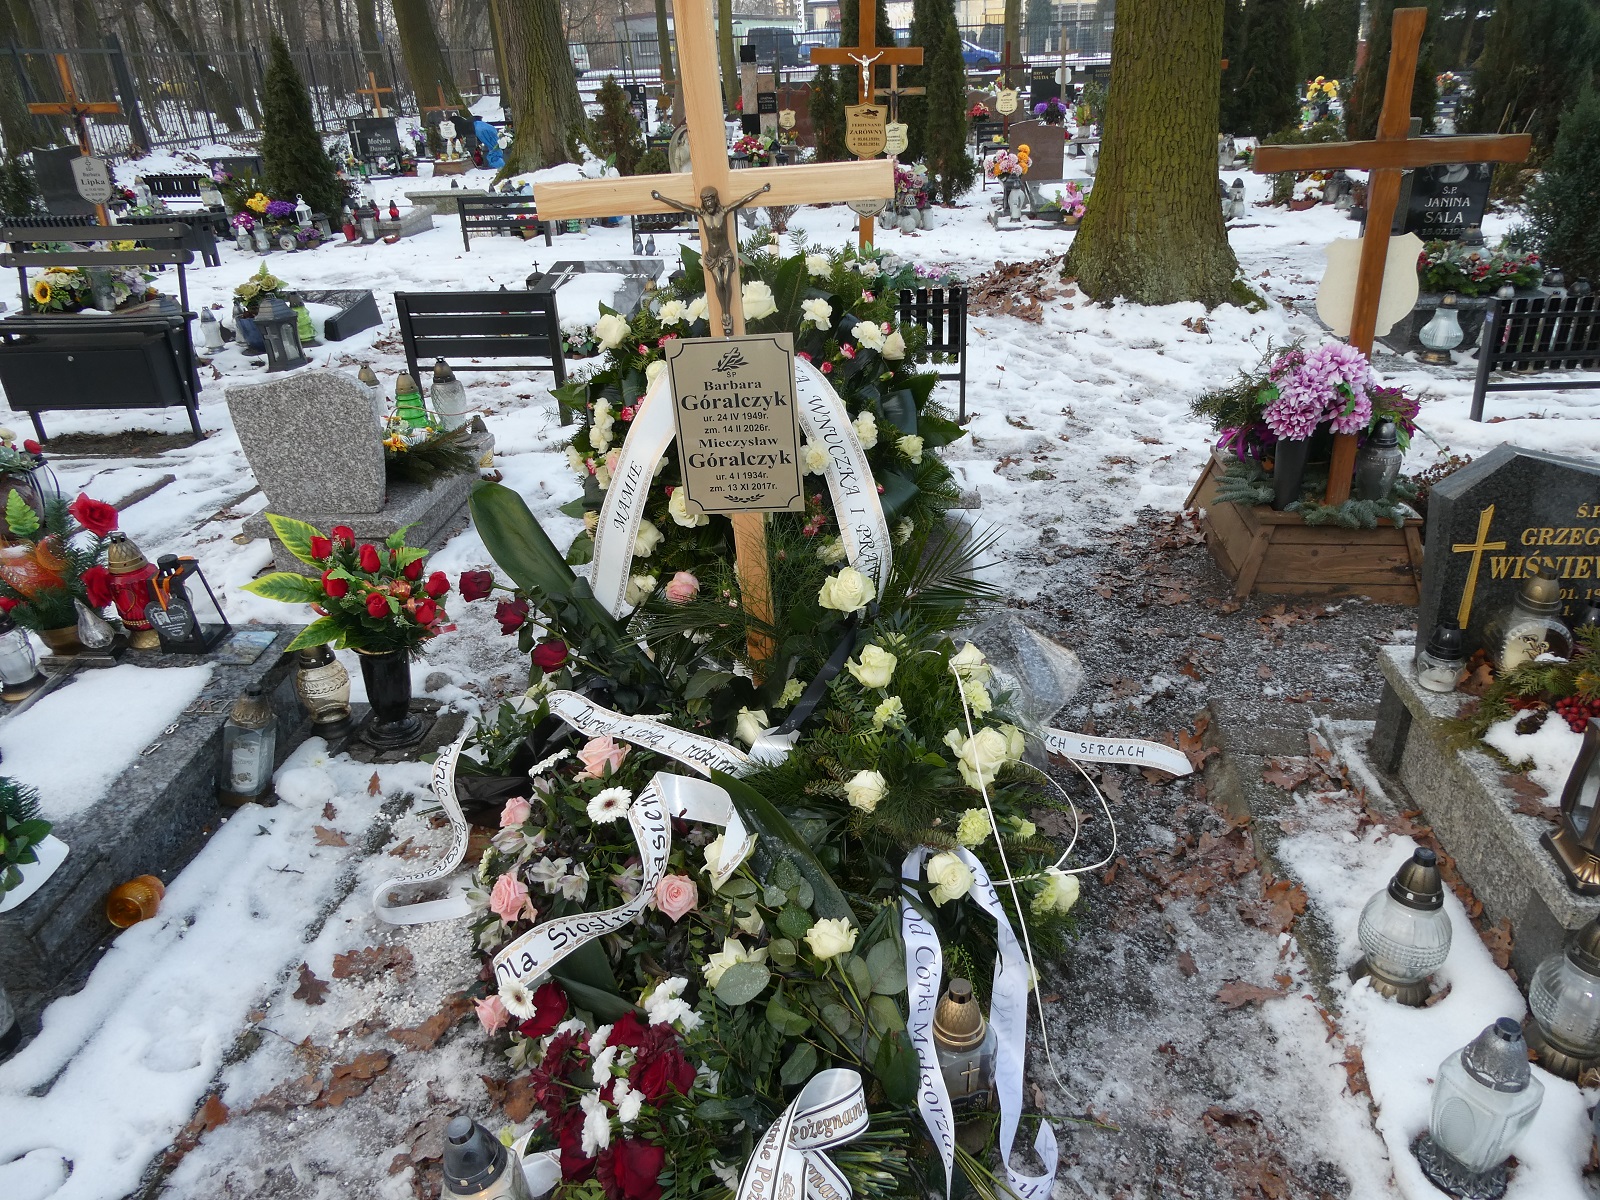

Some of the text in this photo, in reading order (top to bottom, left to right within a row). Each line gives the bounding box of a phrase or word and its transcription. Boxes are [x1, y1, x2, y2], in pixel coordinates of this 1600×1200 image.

[80, 179, 106, 187] Lipka
[1424, 197, 1471, 208] JANINA
[1423, 211, 1464, 224] SALA
[703, 380, 762, 391] Barbara
[681, 391, 788, 411] Góralczyk
[717, 413, 728, 421] 24
[730, 413, 740, 421] IV
[742, 412, 769, 420] 1949r.
[743, 424, 770, 432] 2026r.
[699, 436, 779, 449] Mieczysław
[808, 395, 861, 497] WNUCZKA
[688, 450, 792, 469] Góralczyk
[729, 472, 735, 480] 4
[742, 471, 769, 479] 1934r.
[740, 483, 749, 491] XI
[751, 482, 778, 490] 2017r.
[613, 460, 643, 533] MAMIE
[1520, 527, 1600, 546] GRZEG
[1079, 742, 1145, 758] SERCACH
[547, 907, 641, 951] Siostry
[914, 945, 938, 1014] Córki
[788, 1093, 867, 1142] Pożegnani
